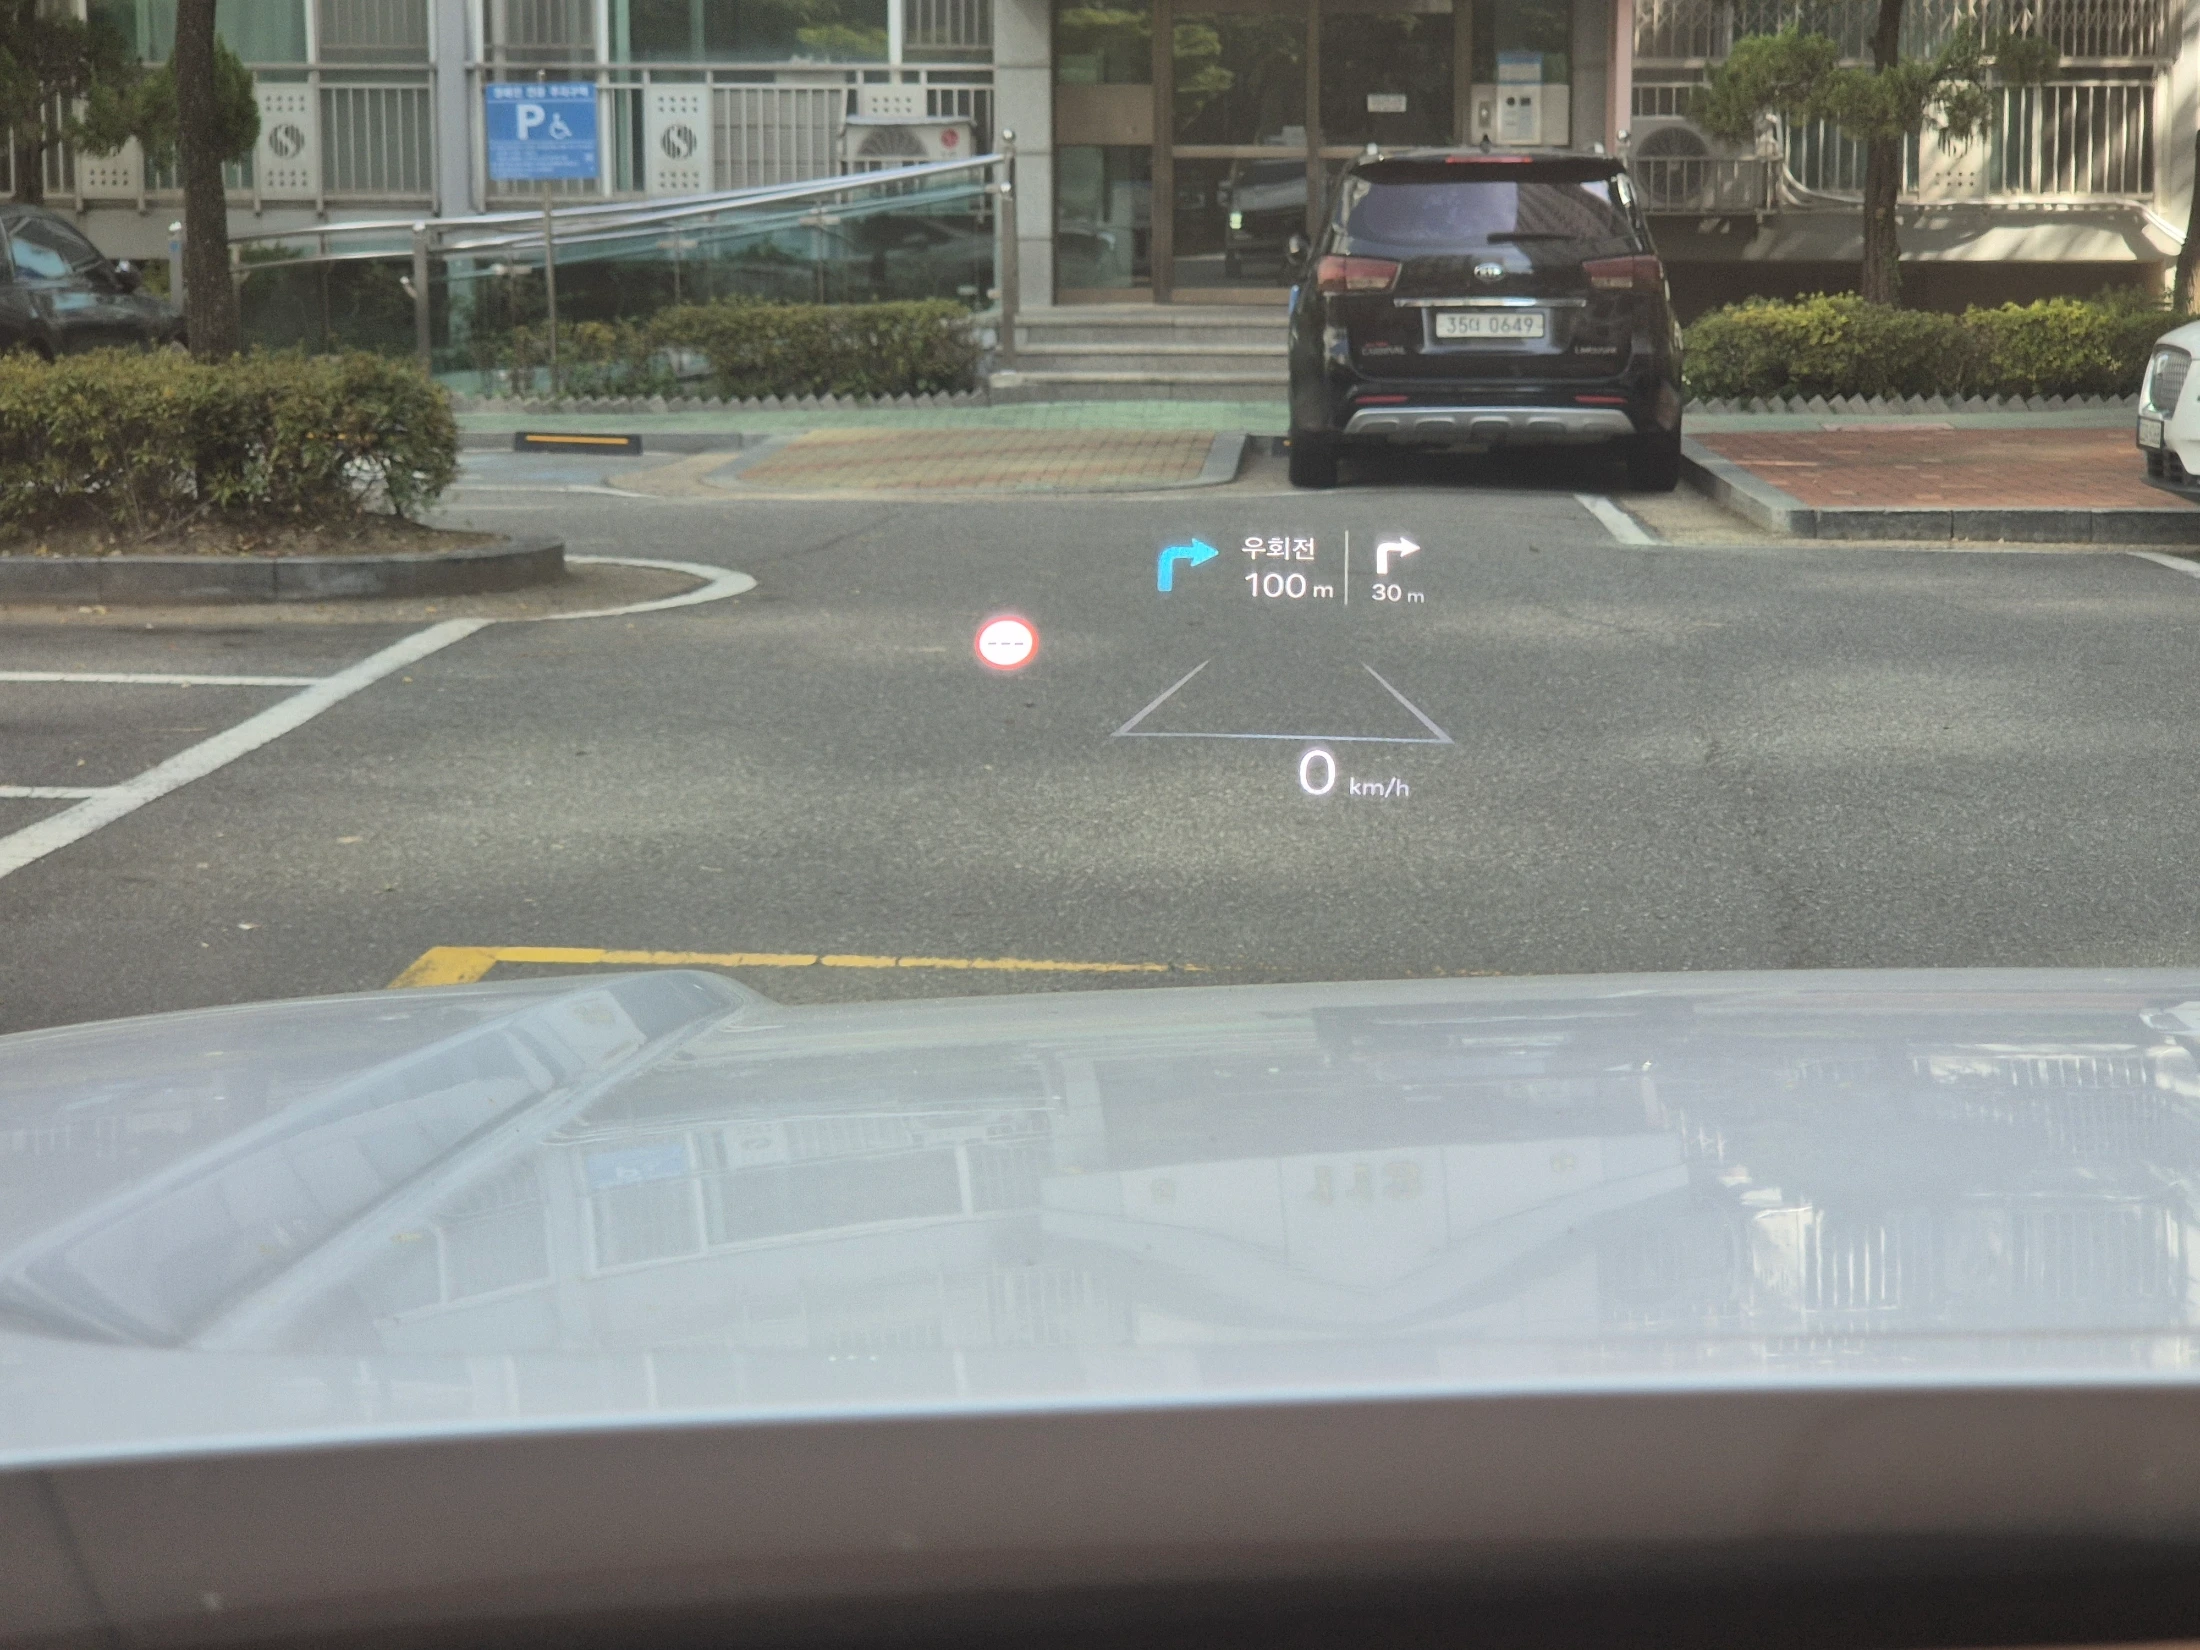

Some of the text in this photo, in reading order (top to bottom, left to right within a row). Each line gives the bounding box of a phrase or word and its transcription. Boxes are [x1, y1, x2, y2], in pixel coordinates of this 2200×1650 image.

[516, 103, 546, 140] P
[1489, 316, 1533, 334] 0649
[1241, 536, 1315, 561] 우회전
[1244, 572, 1334, 599] 100 m
[1371, 583, 1425, 604] 30 m
[1300, 749, 1409, 798] 0 km/h
